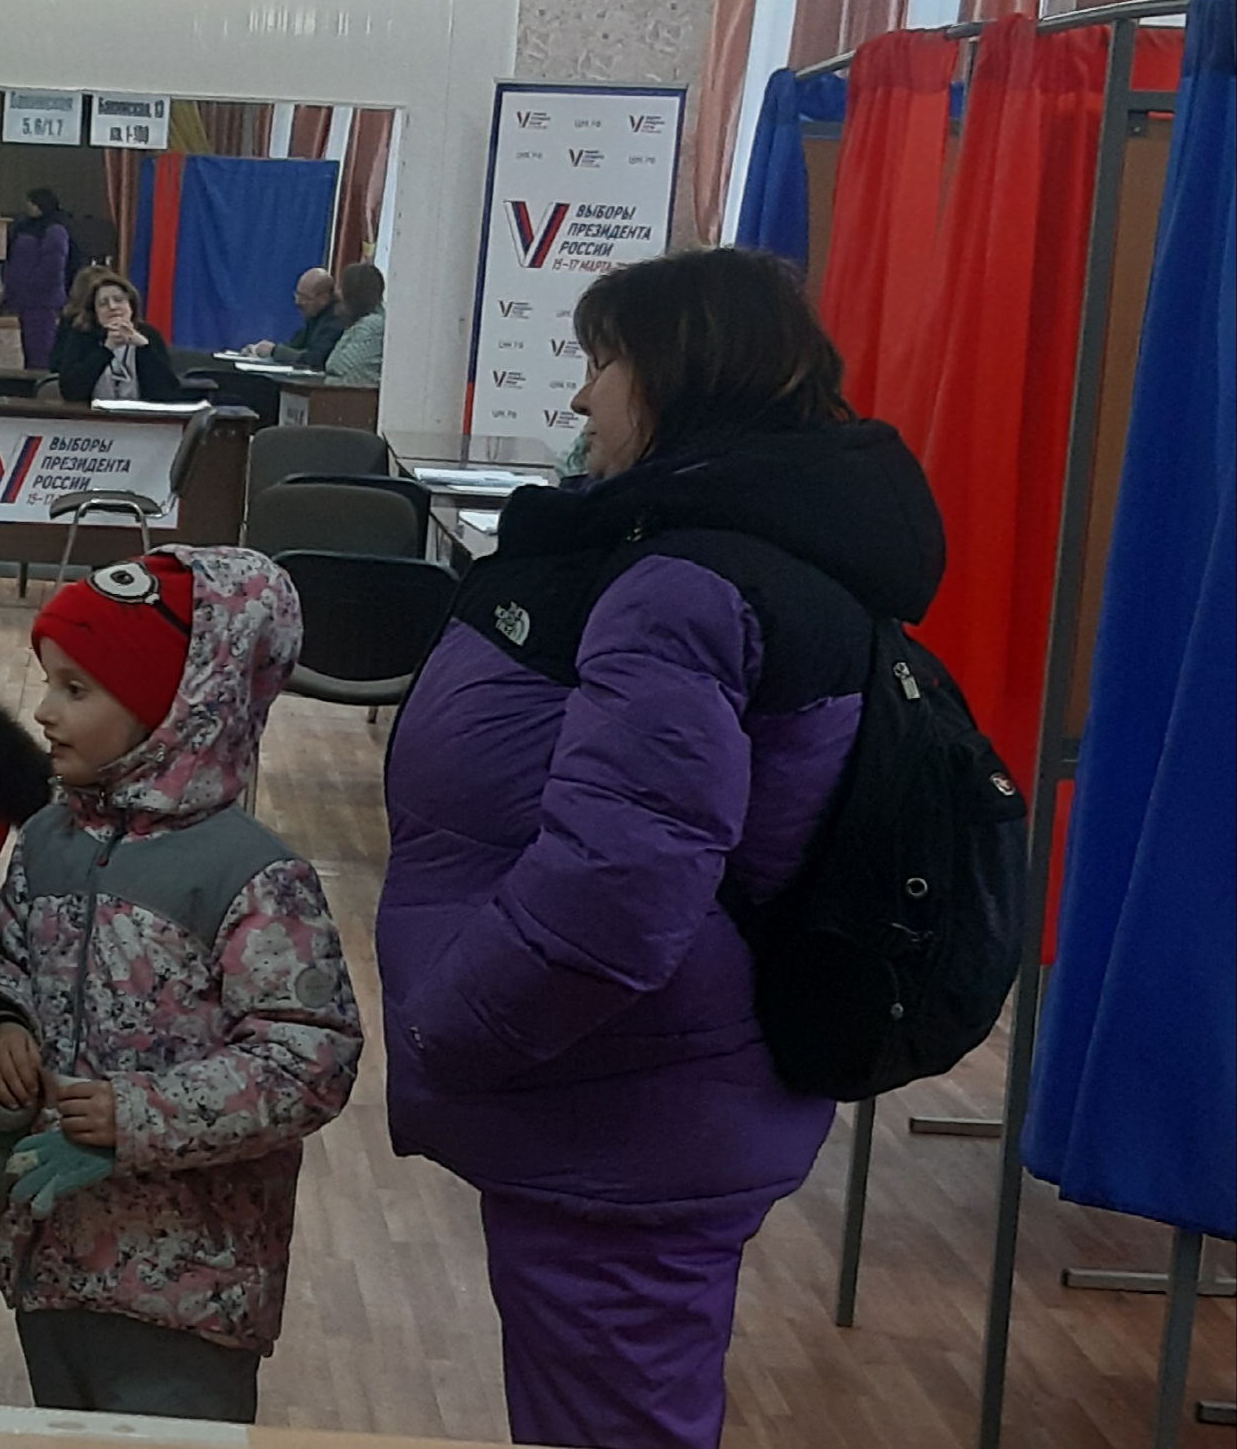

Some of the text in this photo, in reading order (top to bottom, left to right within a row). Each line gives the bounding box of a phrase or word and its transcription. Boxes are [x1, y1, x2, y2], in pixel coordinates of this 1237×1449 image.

[575, 204, 637, 220] ВЫБОРЫ
[566, 222, 653, 241] ПРЕЗИДЕНТА
[558, 241, 614, 257] РОССИИ
[49, 436, 114, 453] ВЫБОРЫ
[40, 455, 132, 473] ПРЕЗИДЕНТА
[32, 474, 92, 491] РОССИИ
